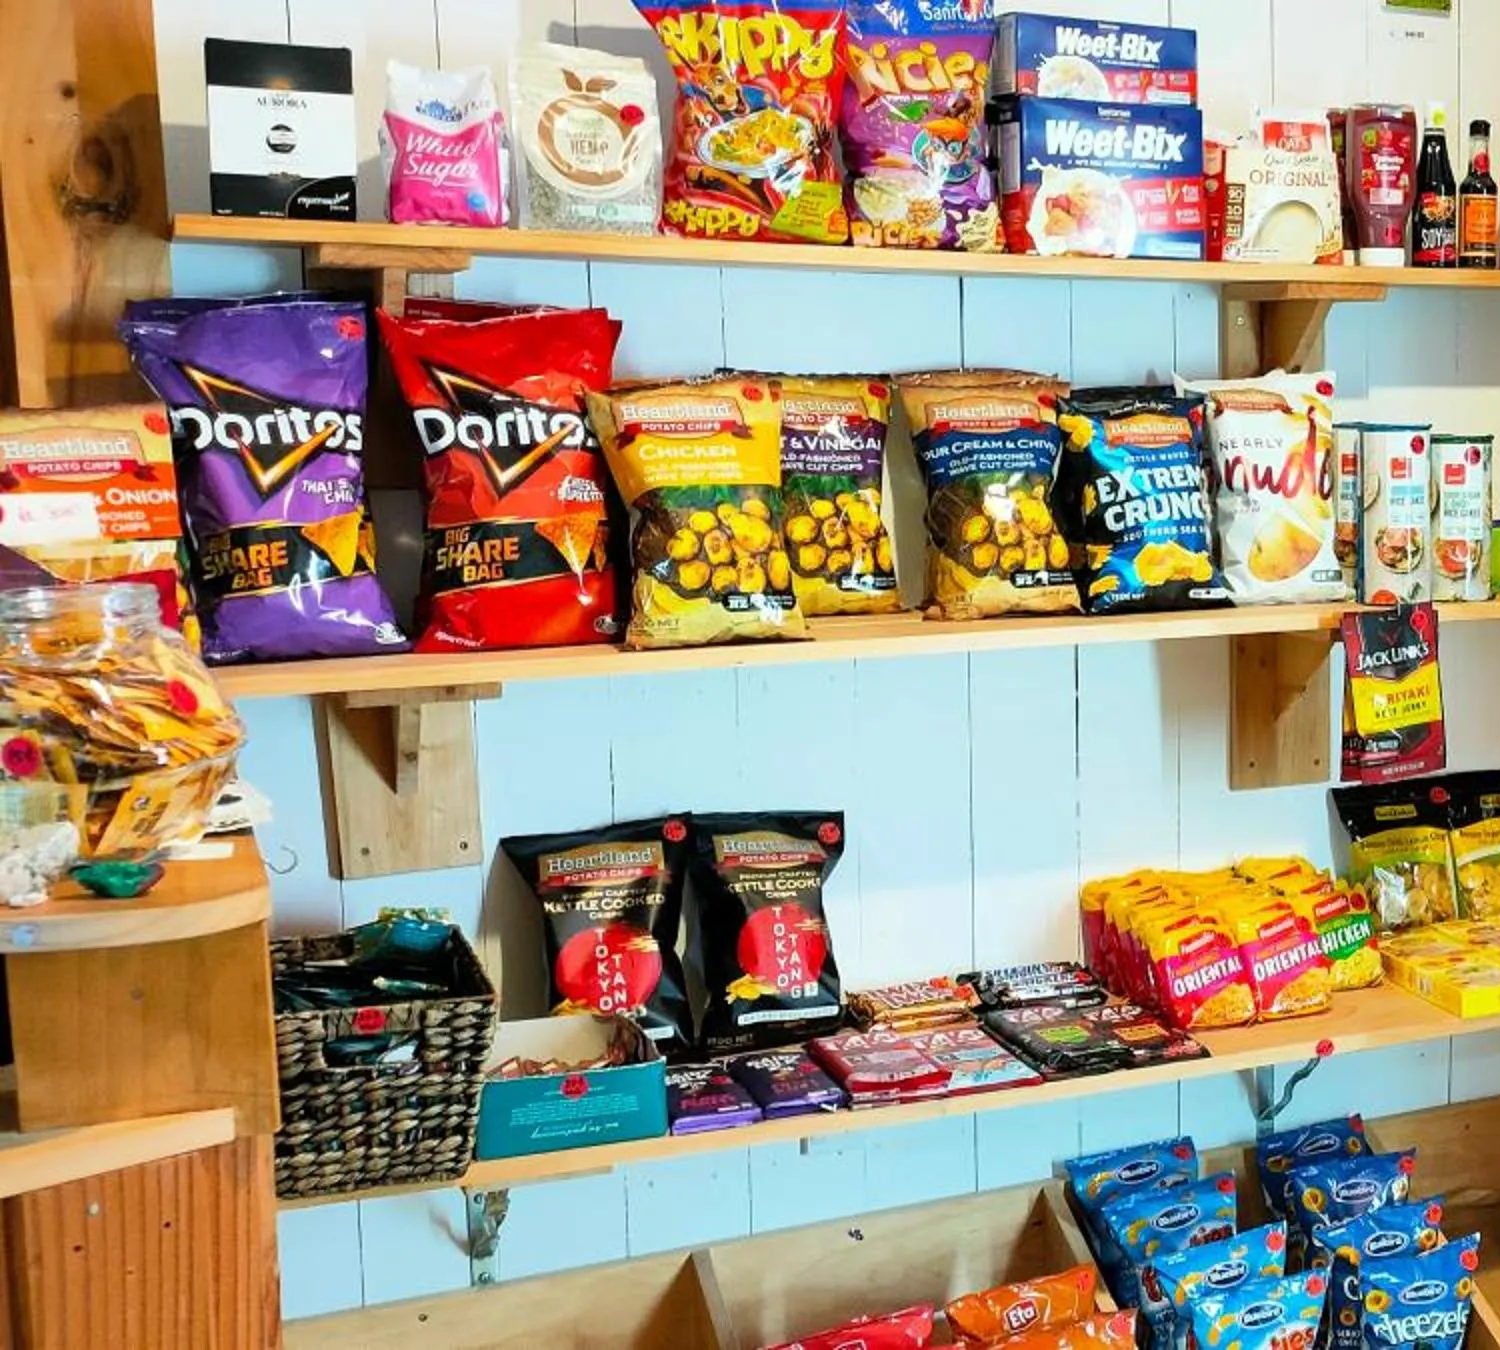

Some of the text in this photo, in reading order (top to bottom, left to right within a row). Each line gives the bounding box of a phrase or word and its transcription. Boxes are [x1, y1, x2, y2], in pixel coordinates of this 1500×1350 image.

[1056, 25, 1163, 63] Weet-Bix
[1045, 119, 1188, 163] Weet-Bix
[403, 153, 480, 188] Sugar
[622, 403, 730, 419] Heartland
[782, 400, 857, 413] eartland
[934, 404, 1030, 418] Heartland
[171, 406, 364, 452] Doritos
[641, 421, 721, 432] POTATO CHIPS
[2, 439, 131, 460] Heartland
[639, 443, 737, 462] CHICKEN
[921, 446, 950, 461] OUR
[951, 440, 1002, 454] CREAM
[1005, 440, 1016, 450] &
[1220, 437, 1284, 451] NEARLY
[27, 461, 122, 474] POTATO CHIPS
[781, 454, 861, 465] LD-FASHIONED
[1096, 463, 1208, 505] EXTREM
[106, 487, 178, 506] ONION
[1104, 490, 1210, 533] CRUNC
[444, 526, 470, 543] BIG
[201, 540, 289, 581] SHARE
[434, 538, 520, 572] SHARE
[231, 567, 273, 589] BAG
[463, 563, 505, 583] BAG
[1373, 685, 1431, 709] RIYAKI
[547, 847, 658, 874] Heartland
[563, 867, 644, 884] POTATO CHIPS
[771, 906, 789, 988] TOKYO
[1320, 919, 1371, 955] HICKEN
[594, 927, 614, 1012] TOKYO
[1253, 939, 1322, 982] ORIENTAL
[1172, 955, 1243, 998] ORIENTAL
[1008, 1305, 1035, 1331] Eta
